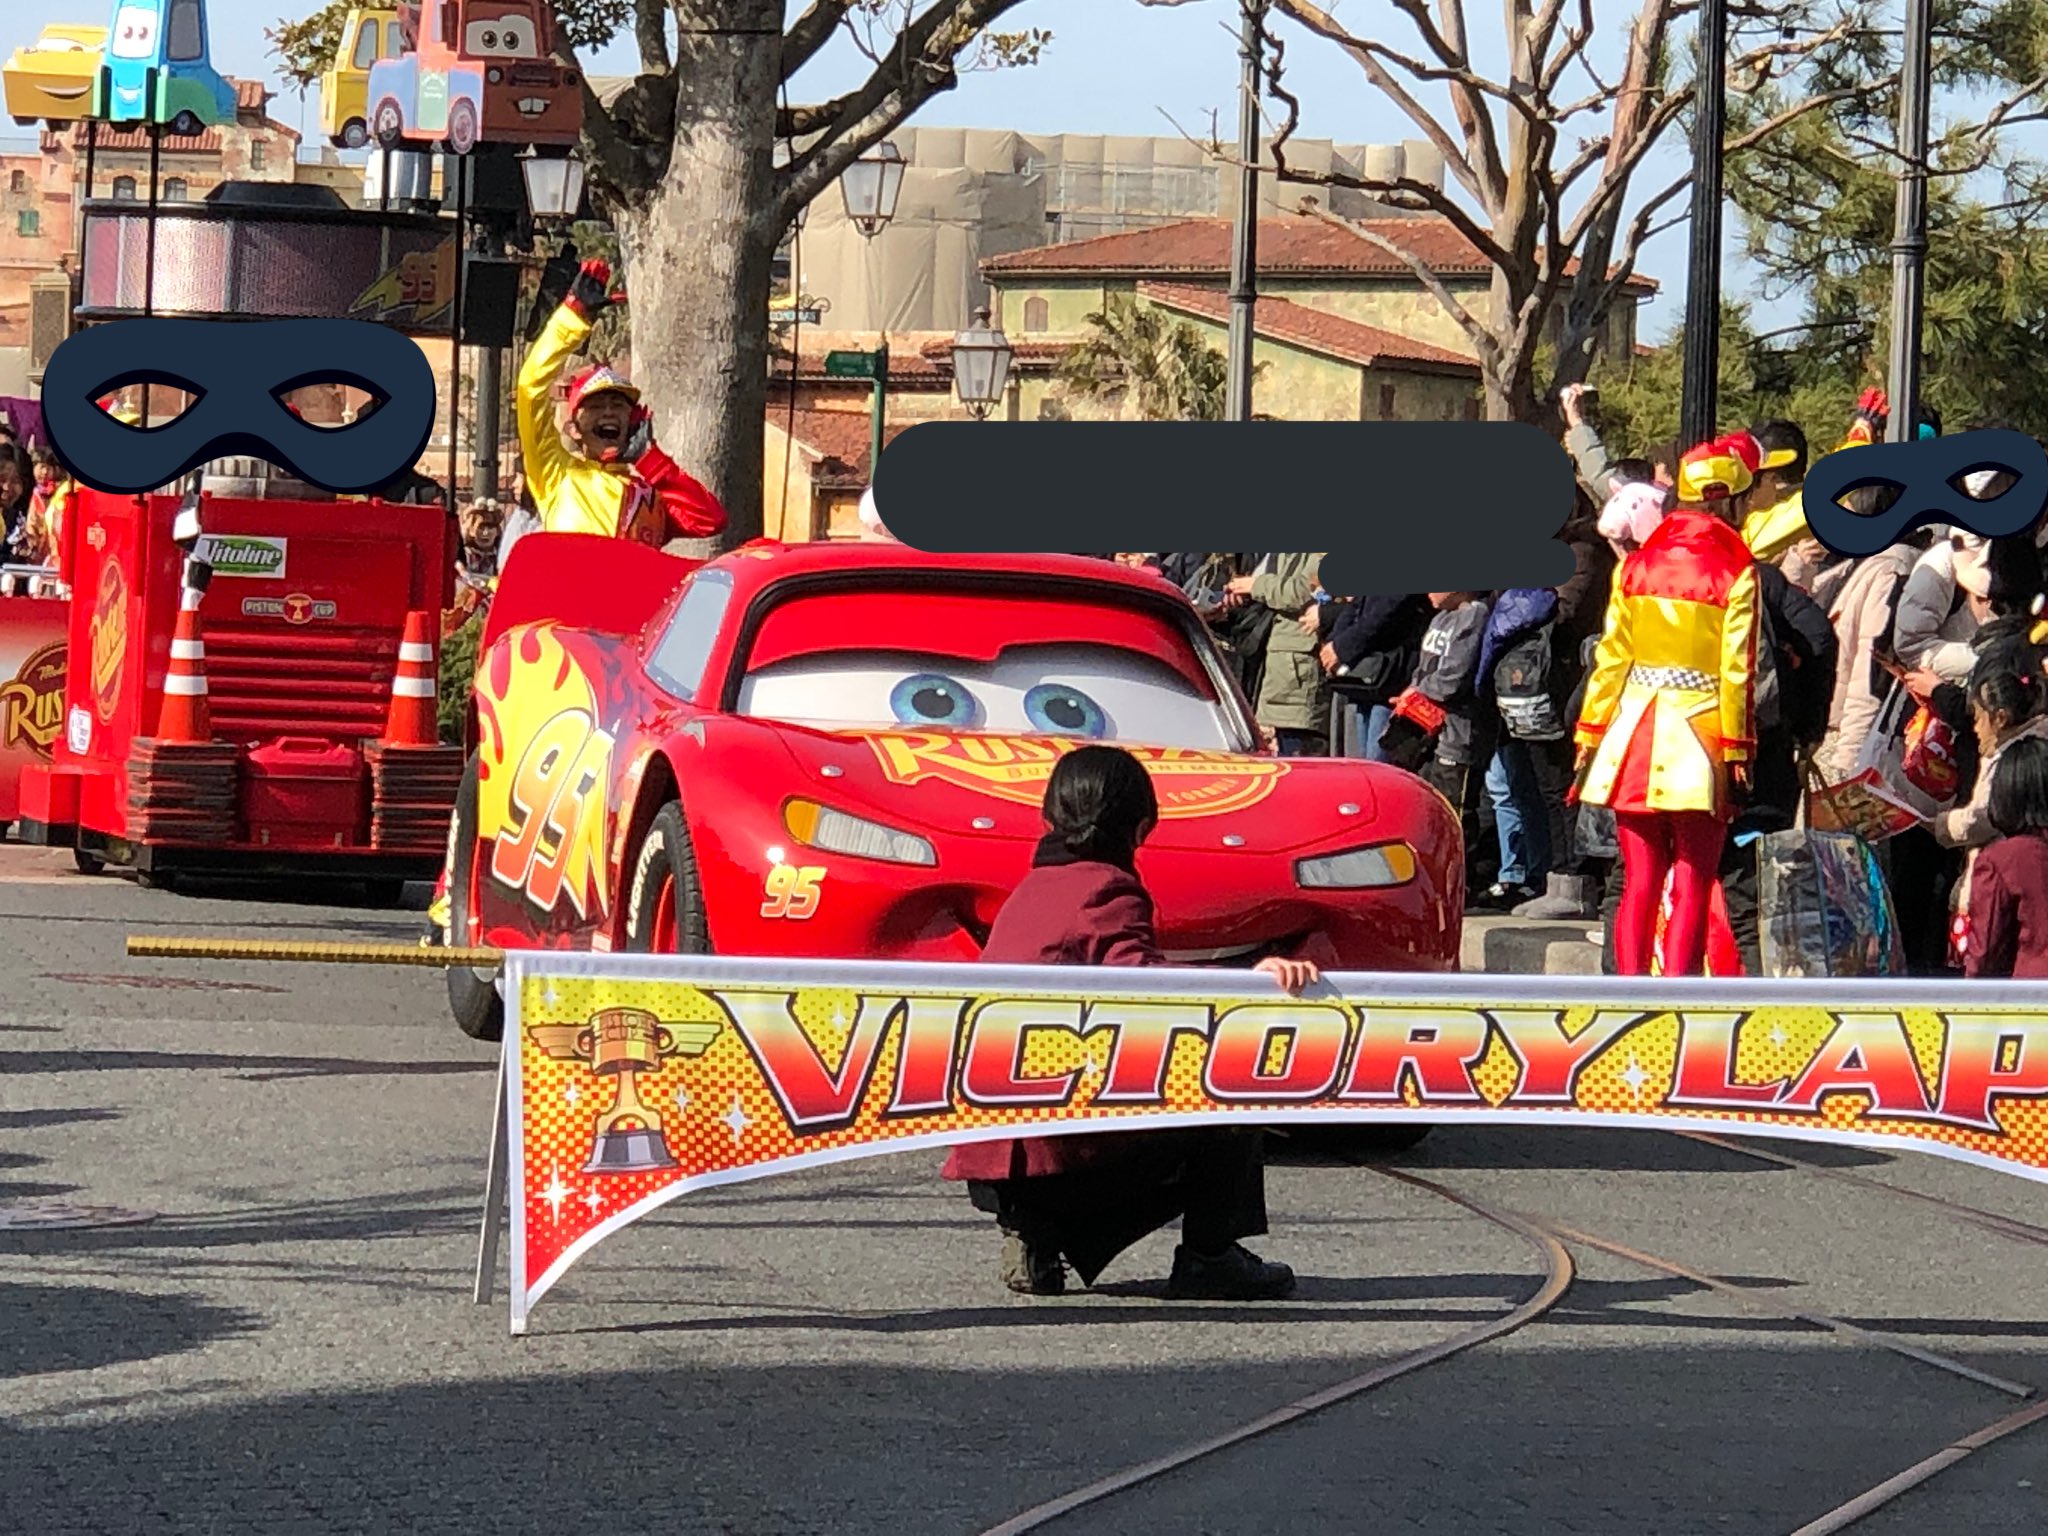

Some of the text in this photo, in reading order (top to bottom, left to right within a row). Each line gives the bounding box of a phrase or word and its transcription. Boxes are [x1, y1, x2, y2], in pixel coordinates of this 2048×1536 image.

[492, 707, 615, 913] 95
[760, 863, 827, 918] 95
[708, 990, 2048, 1134] VICTORY LAP
